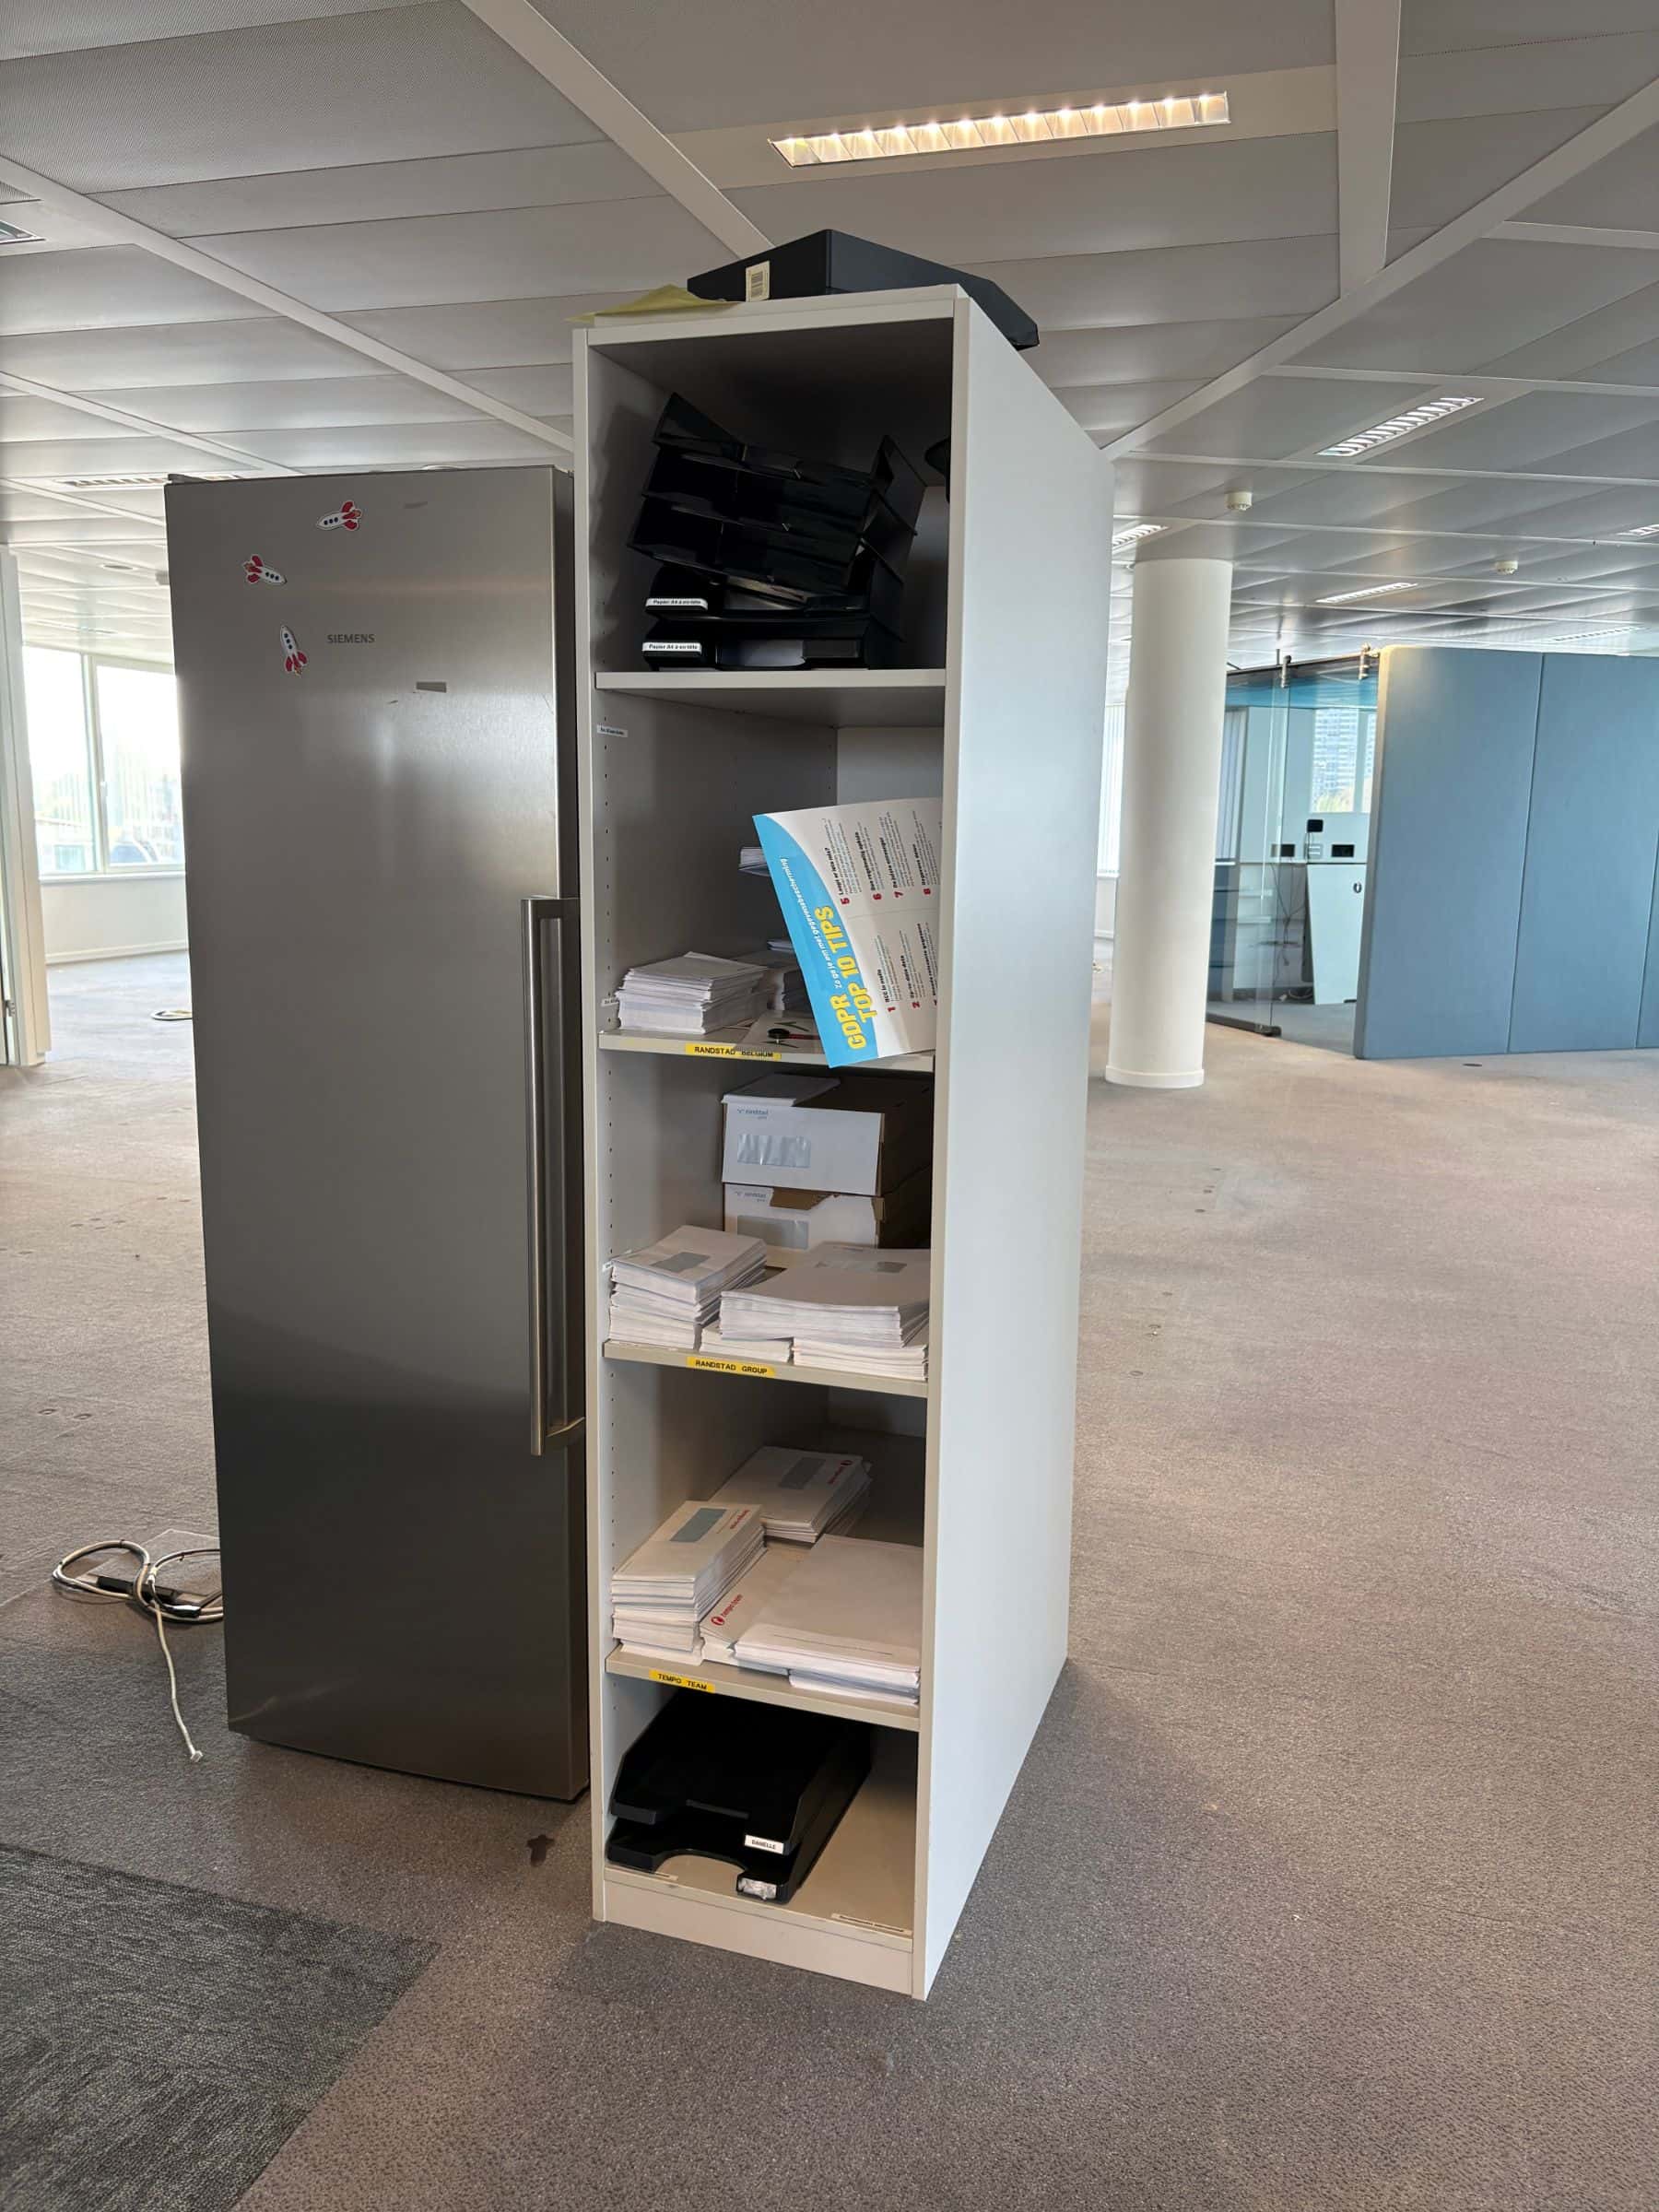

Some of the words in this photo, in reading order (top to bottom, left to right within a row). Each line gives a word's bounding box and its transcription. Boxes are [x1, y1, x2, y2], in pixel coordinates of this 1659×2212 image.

[326, 634, 375, 643] SIEMENS
[780, 858, 818, 934] gegevensbescherming
[873, 892, 880, 900] 6
[895, 889, 902, 898] 7
[924, 887, 930, 895] 8
[841, 896, 849, 905] 5
[815, 906, 848, 954] TIPS
[813, 935, 826, 948] met
[837, 957, 858, 979] 10
[848, 982, 877, 1023] TOP
[912, 1000, 919, 1008] 2
[830, 994, 866, 1049] GDPR
[694, 1046, 735, 1055] RANDSTAD
[695, 1359, 735, 1371] RANDSTAD
[741, 1365, 767, 1374] GROUP
[657, 1674, 681, 1683] TEMPO
[687, 1680, 707, 1689] TEAM
